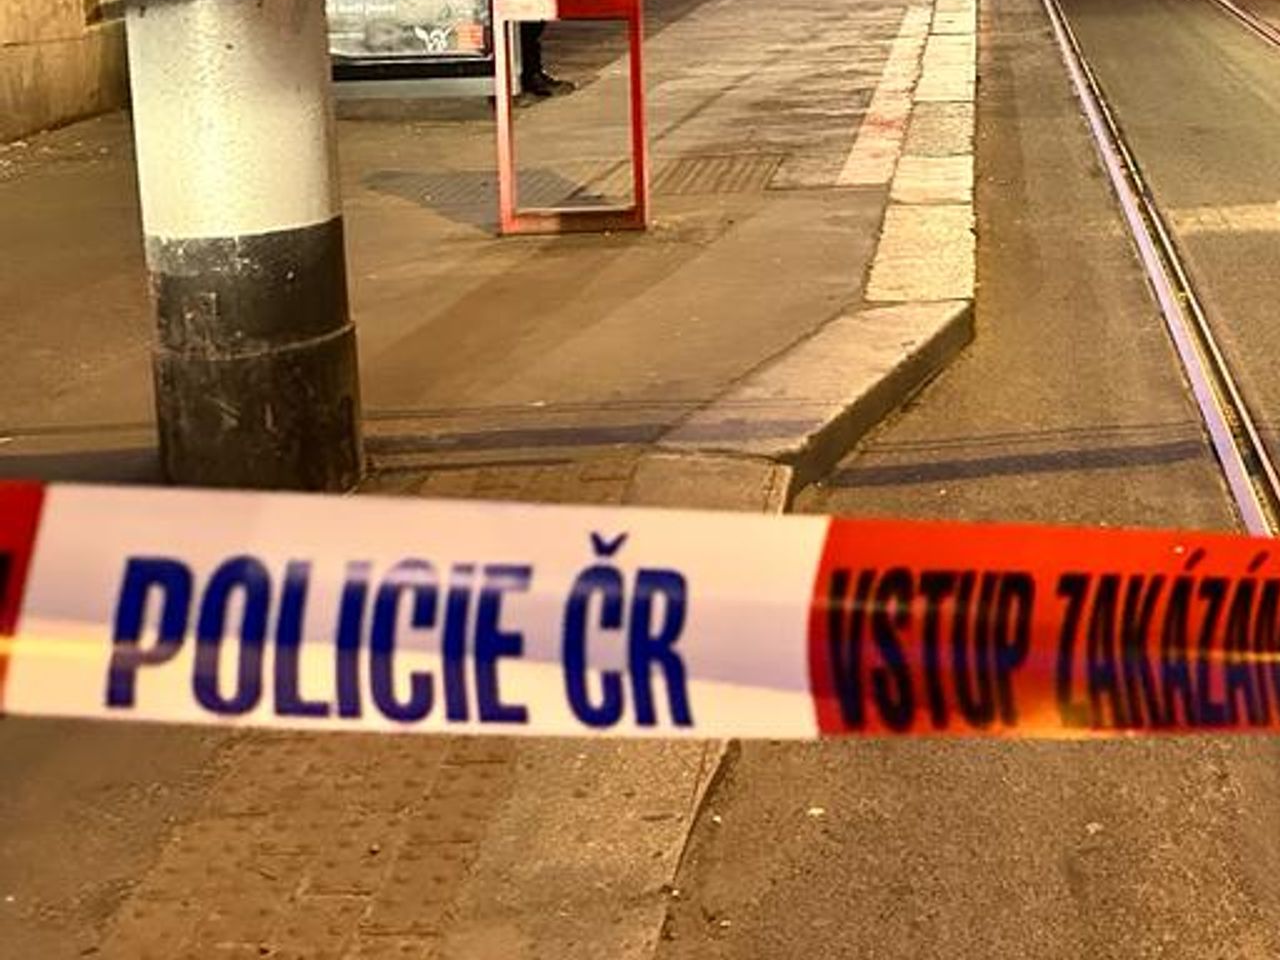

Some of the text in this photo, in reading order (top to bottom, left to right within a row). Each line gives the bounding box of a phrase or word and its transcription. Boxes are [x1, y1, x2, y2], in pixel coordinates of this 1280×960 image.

[105, 554, 533, 725] POLICIE
[563, 531, 694, 728] ČR
[826, 567, 1036, 731] VSTUP
